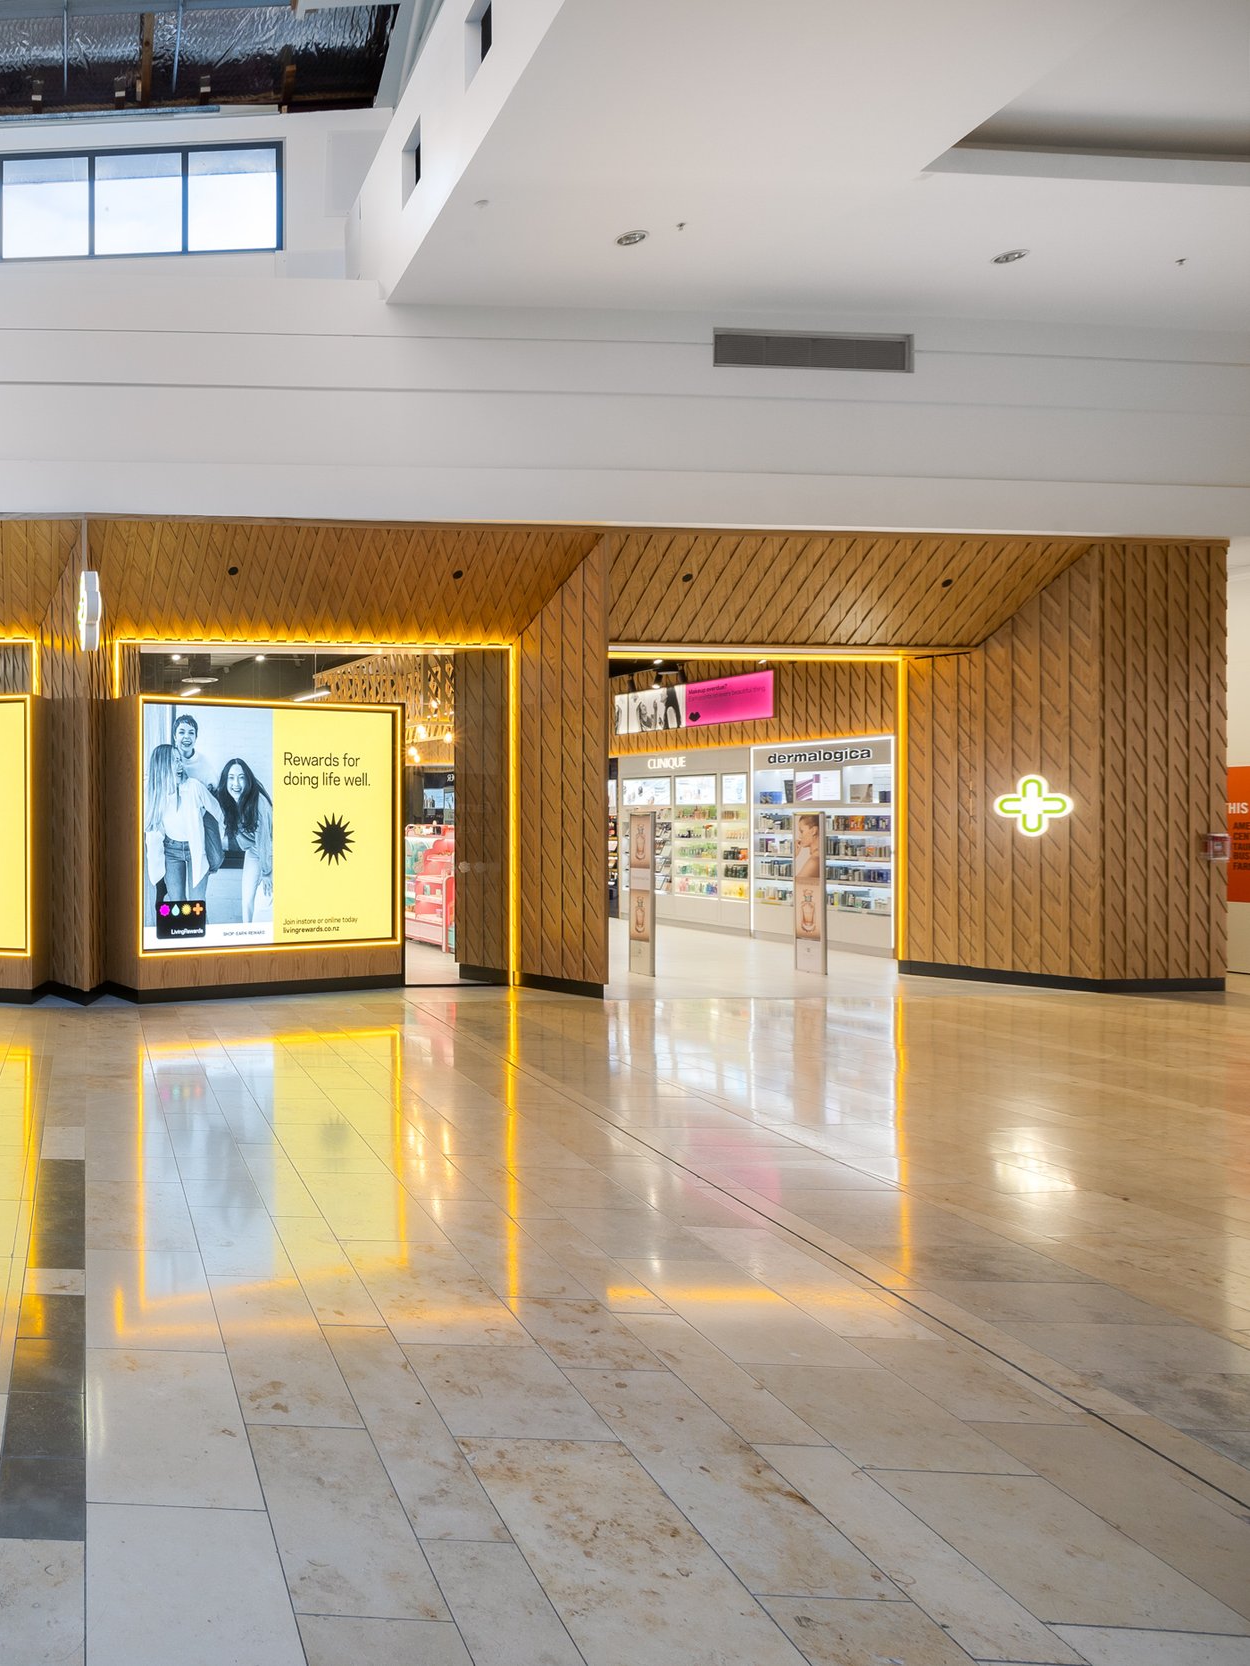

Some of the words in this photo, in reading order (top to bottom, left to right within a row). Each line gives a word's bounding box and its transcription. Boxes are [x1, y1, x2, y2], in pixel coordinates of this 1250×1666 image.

[283, 751, 340, 767] Rewards
[343, 752, 361, 767] for
[647, 756, 686, 770] CLINIQUE
[767, 747, 871, 765] dermalogica
[283, 771, 319, 790] doing
[322, 772, 341, 786] life
[344, 772, 371, 787] well.
[282, 918, 295, 926] Join
[296, 917, 316, 925] instore
[324, 916, 341, 924] online
[342, 916, 358, 924] today
[282, 925, 340, 934] livingrewards.co.nz
